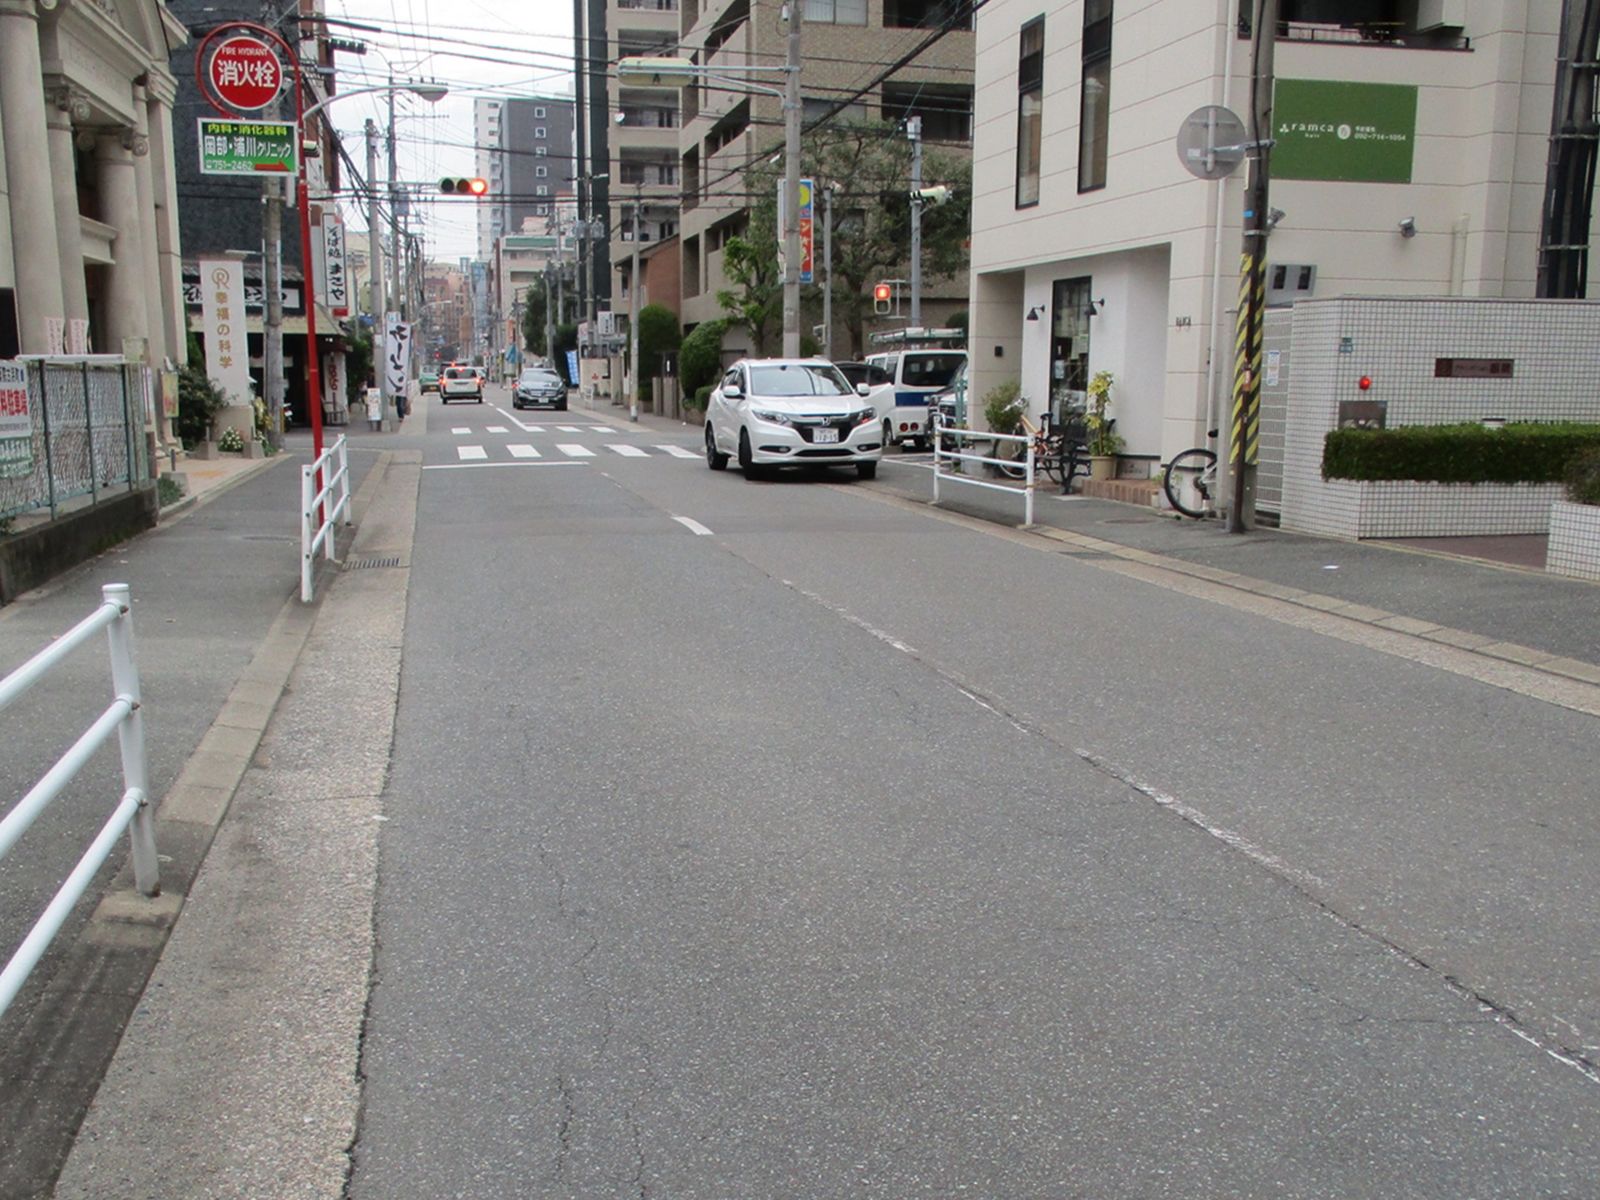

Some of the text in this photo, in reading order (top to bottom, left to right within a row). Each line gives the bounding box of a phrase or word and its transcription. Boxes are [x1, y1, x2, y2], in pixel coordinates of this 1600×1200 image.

[222, 47, 268, 56] FIRE HYDRANT
[218, 60, 276, 88] 消火栓
[208, 124, 287, 136] 内科・消化器科
[1291, 123, 1334, 132] ramca
[215, 291, 233, 369] 幸福の科学
